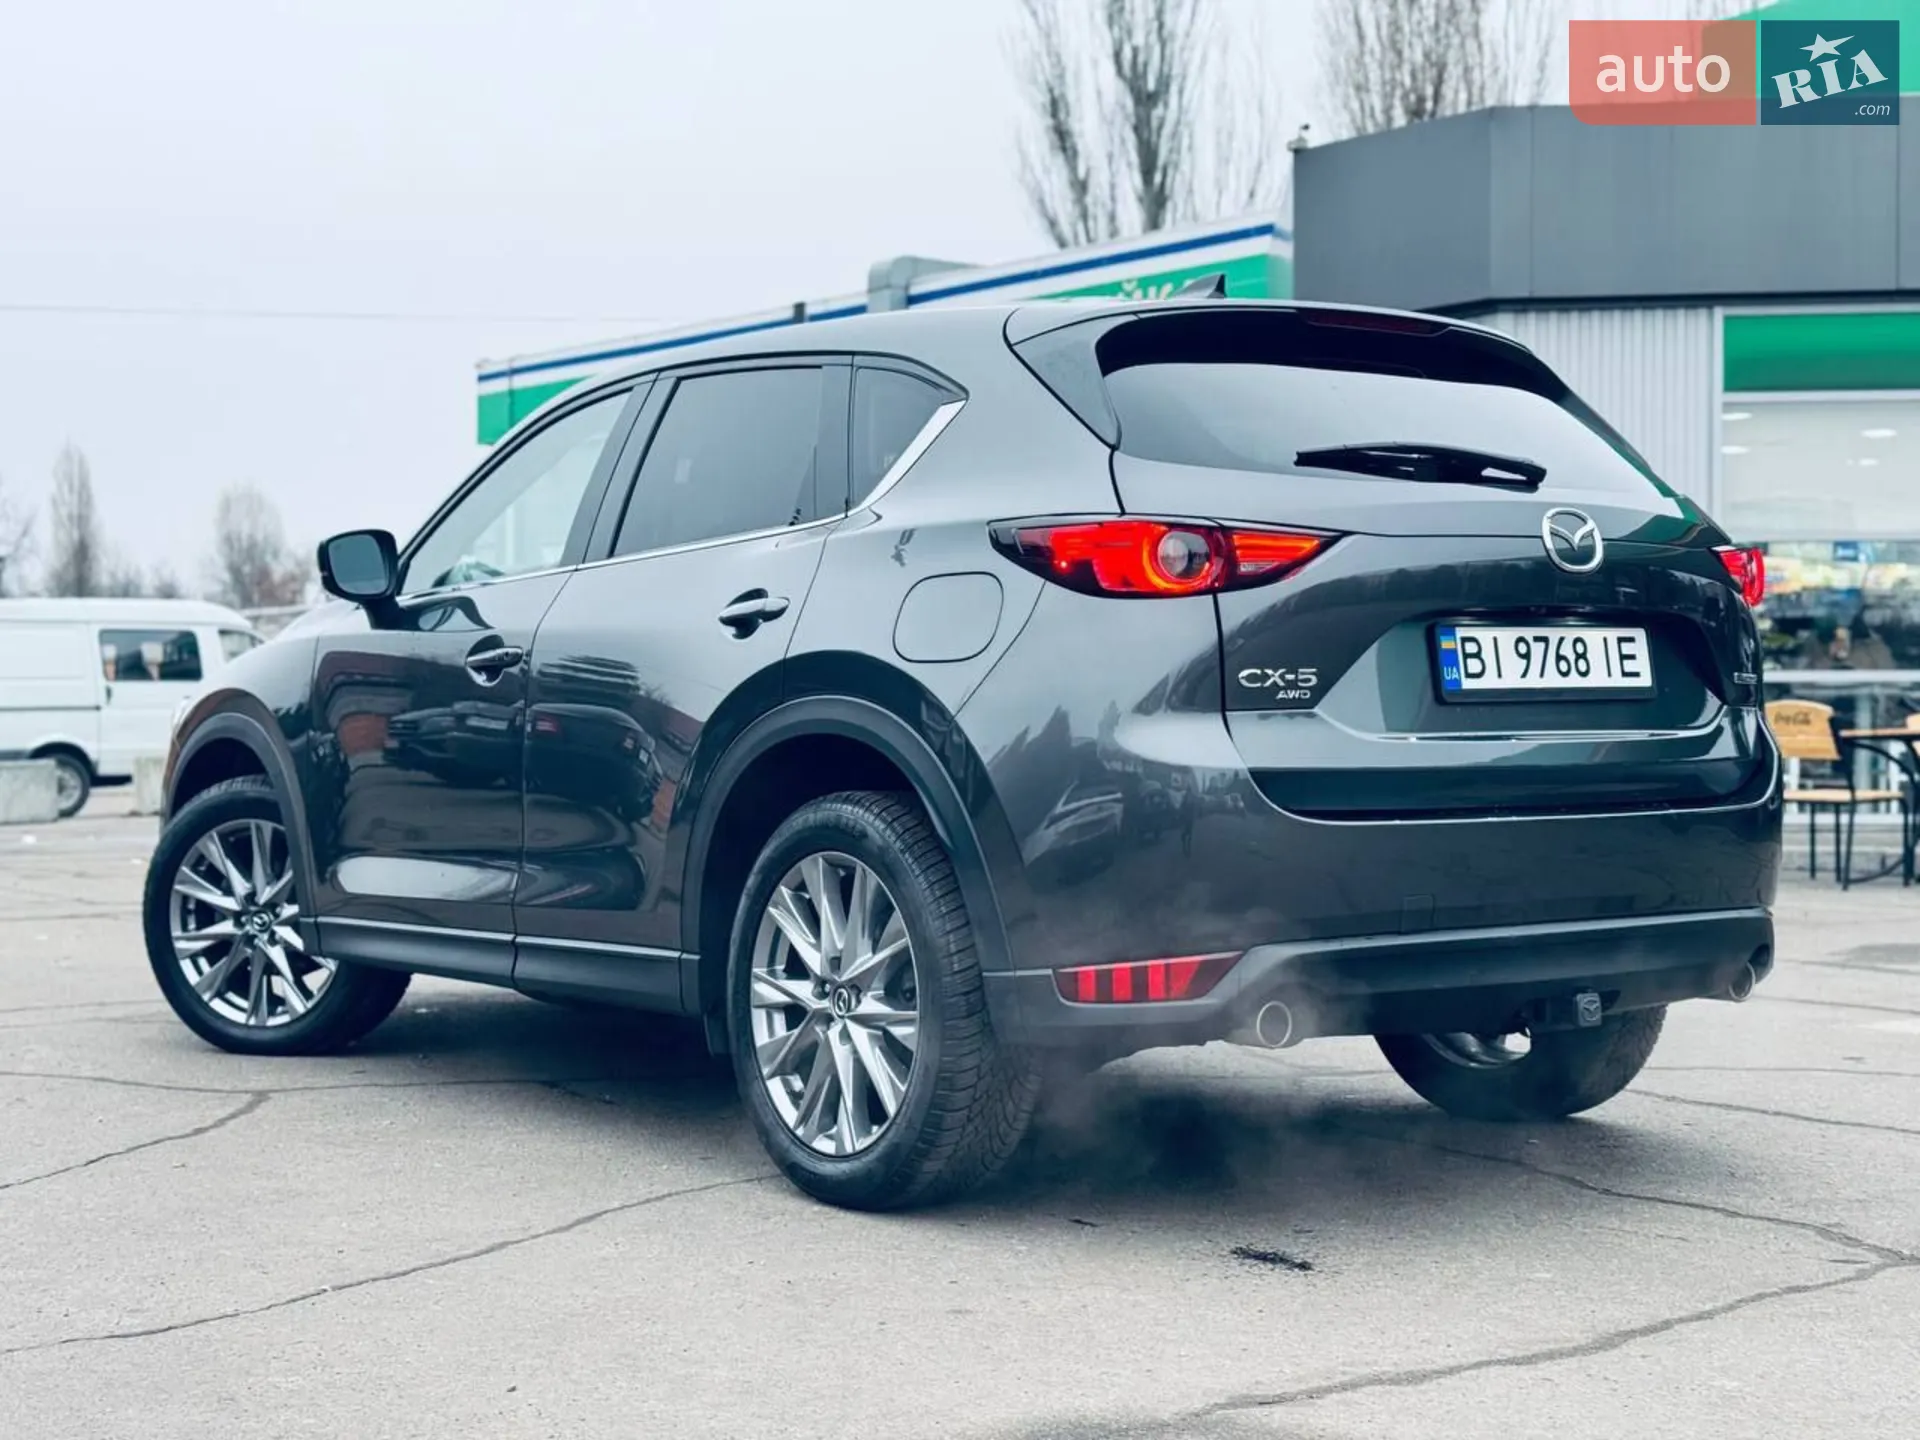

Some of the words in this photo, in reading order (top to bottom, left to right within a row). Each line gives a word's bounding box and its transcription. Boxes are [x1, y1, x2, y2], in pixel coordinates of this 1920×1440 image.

[1460, 636, 1502, 678] BI
[1513, 636, 1590, 678] 9768
[1603, 636, 1641, 677] IE
[1238, 668, 1318, 687] CX-5
[1444, 667, 1459, 680] UA
[1276, 689, 1311, 699] AWD
